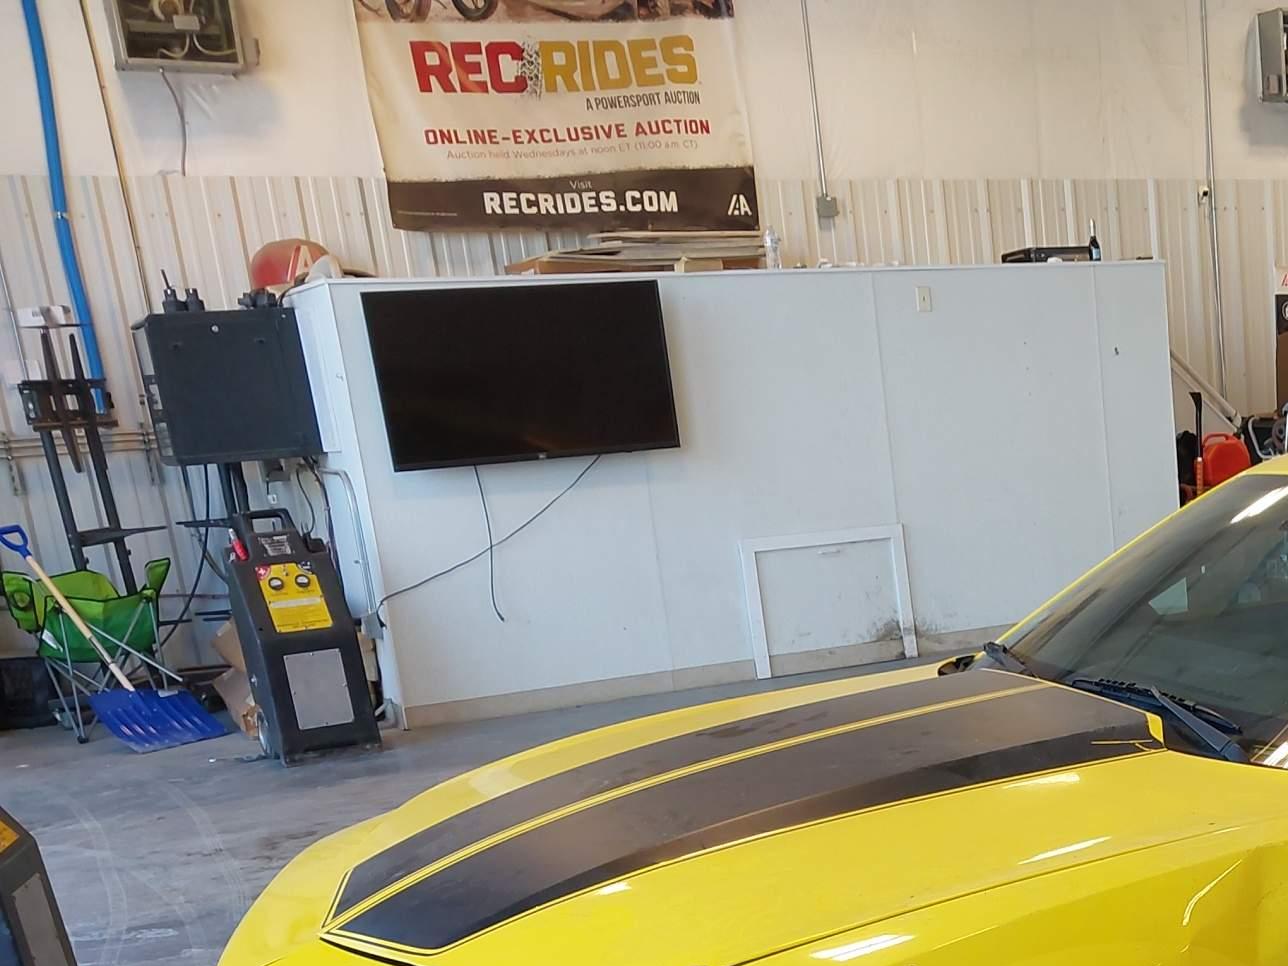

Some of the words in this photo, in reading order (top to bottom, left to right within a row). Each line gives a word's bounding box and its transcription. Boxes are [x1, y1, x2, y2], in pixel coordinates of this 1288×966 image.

[409, 40, 528, 94] REC
[540, 34, 700, 93] RIDES
[586, 98, 595, 111] A
[595, 92, 663, 111] POWERSPORT
[664, 90, 701, 106] AUCTION
[424, 122, 628, 146] ONLINE-EXCLUSIVE
[634, 119, 711, 137] AUCTION
[447, 150, 487, 160] Auction
[513, 148, 575, 160] Wednesdays
[569, 179, 592, 190] Visit
[483, 190, 678, 216] RECRIDES.COM
